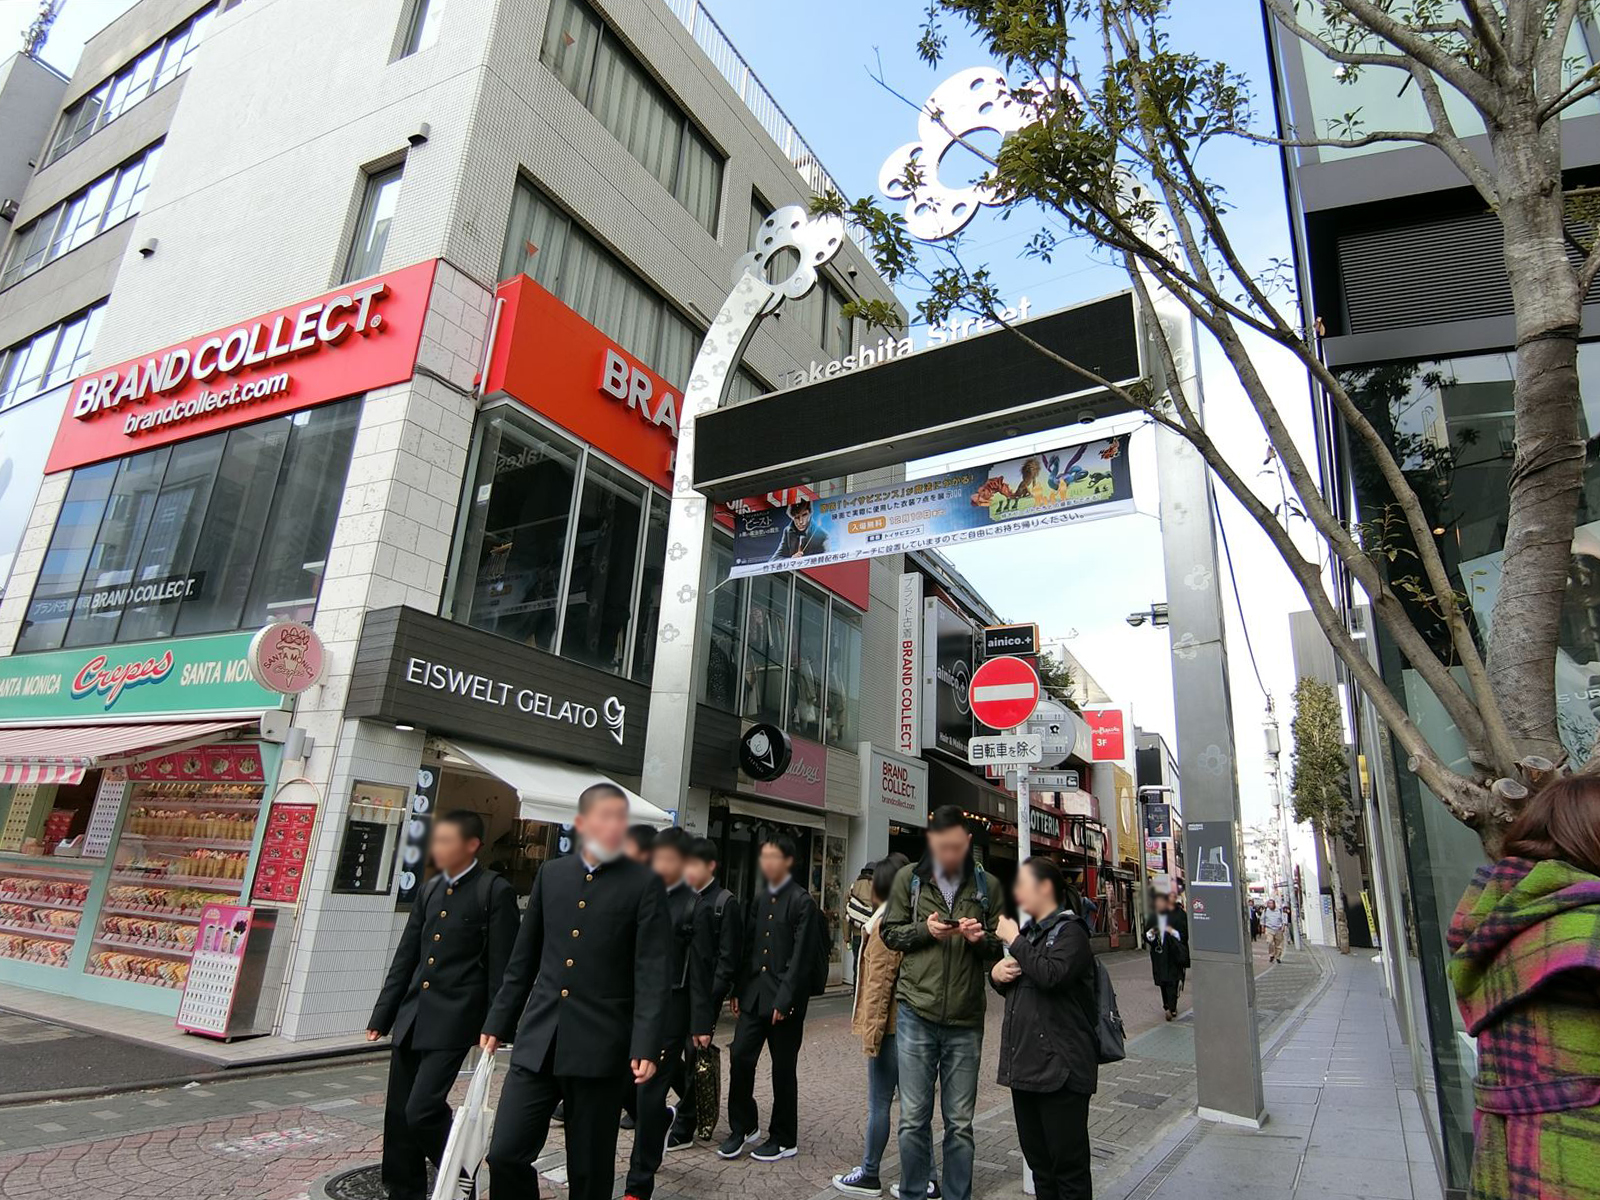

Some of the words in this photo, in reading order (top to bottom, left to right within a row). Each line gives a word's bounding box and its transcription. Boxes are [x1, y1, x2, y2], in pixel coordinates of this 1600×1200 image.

[73, 348, 191, 419] BRAND
[123, 371, 289, 435] brandcollect.com
[180, 661, 222, 687] SANTA
[263, 652, 288, 669] SANTA
[290, 653, 315, 679] MONICA
[901, 640, 913, 686] BRAND
[24, 673, 63, 696] MONICA
[72, 649, 174, 706] Crepes
[406, 657, 513, 706] EISWELT
[516, 689, 598, 729] GELATO
[972, 741, 1037, 760] 自転車を除く
[1096, 738, 1107, 747] 3F
[882, 760, 908, 782] BRAND
